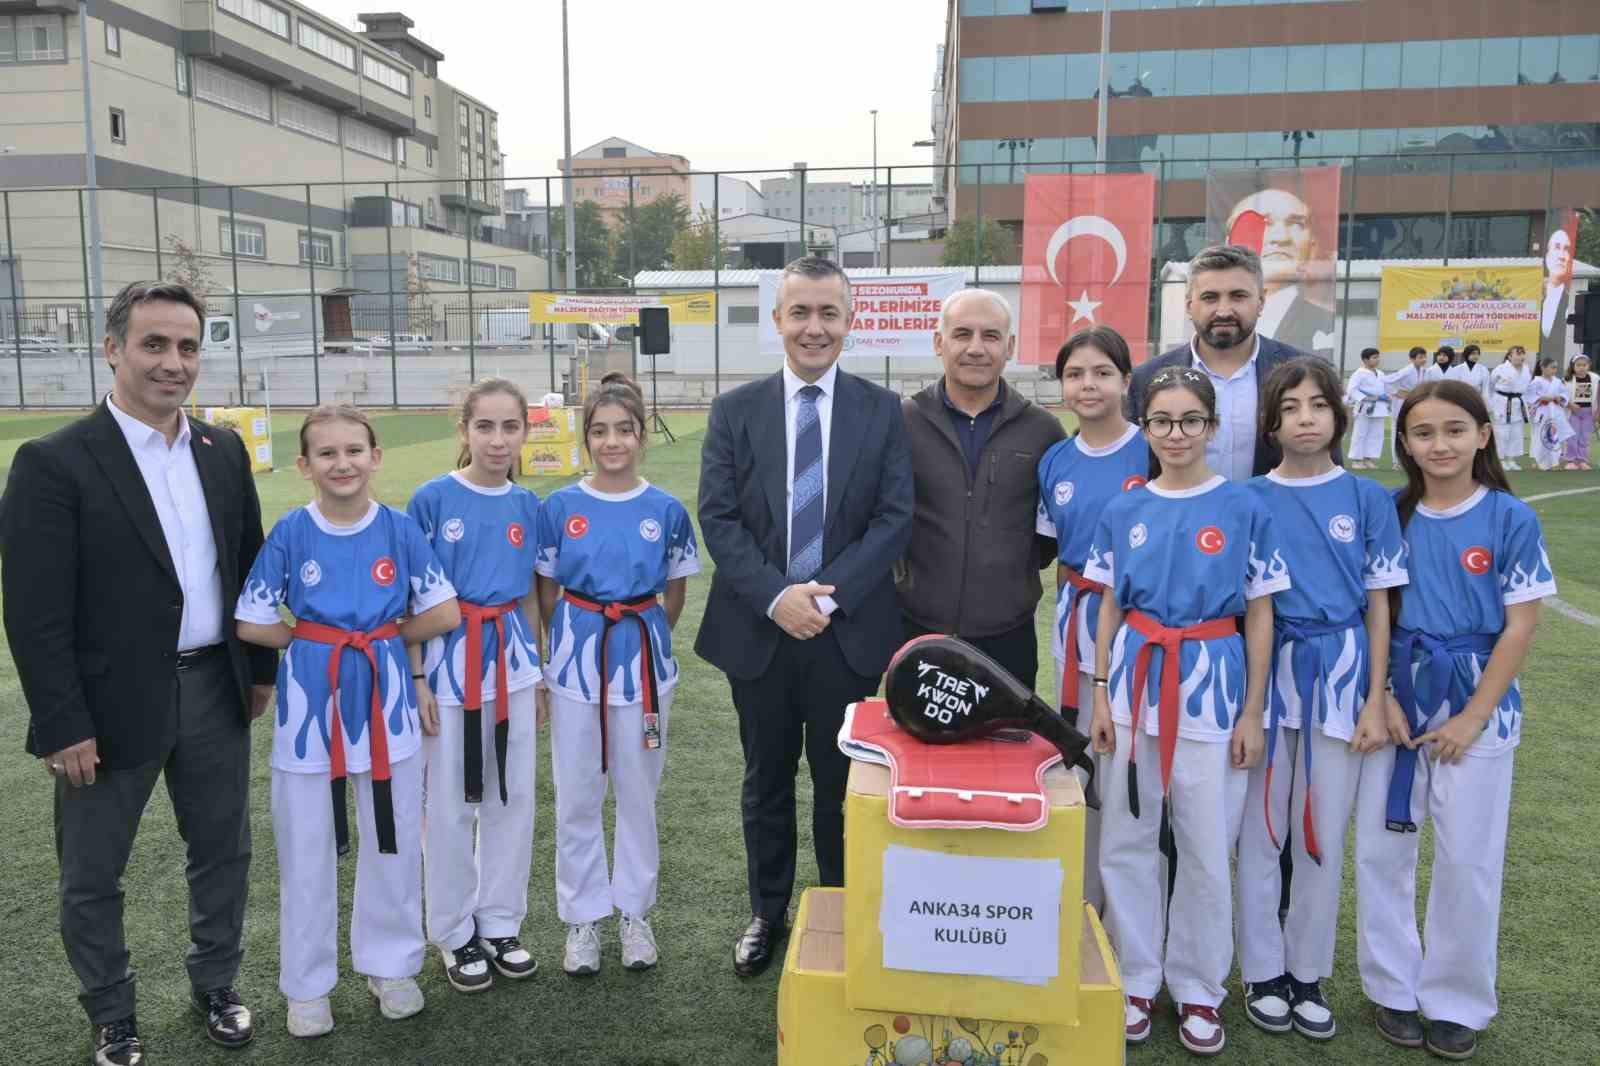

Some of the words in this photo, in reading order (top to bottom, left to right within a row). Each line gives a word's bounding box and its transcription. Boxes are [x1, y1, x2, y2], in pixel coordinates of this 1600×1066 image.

[858, 286, 921, 296] SEZONUNDA
[878, 314, 938, 330] DİLERİZ
[1406, 312, 1447, 320] MALZEME
[1487, 311, 1537, 320] TÖRENİMİZE
[936, 671, 970, 696] TAE
[917, 683, 973, 716] KWON
[924, 703, 953, 724] DO
[909, 900, 980, 918] ANKA34
[986, 904, 1033, 920] SPOR
[934, 926, 1007, 945] KULÜBÜ
